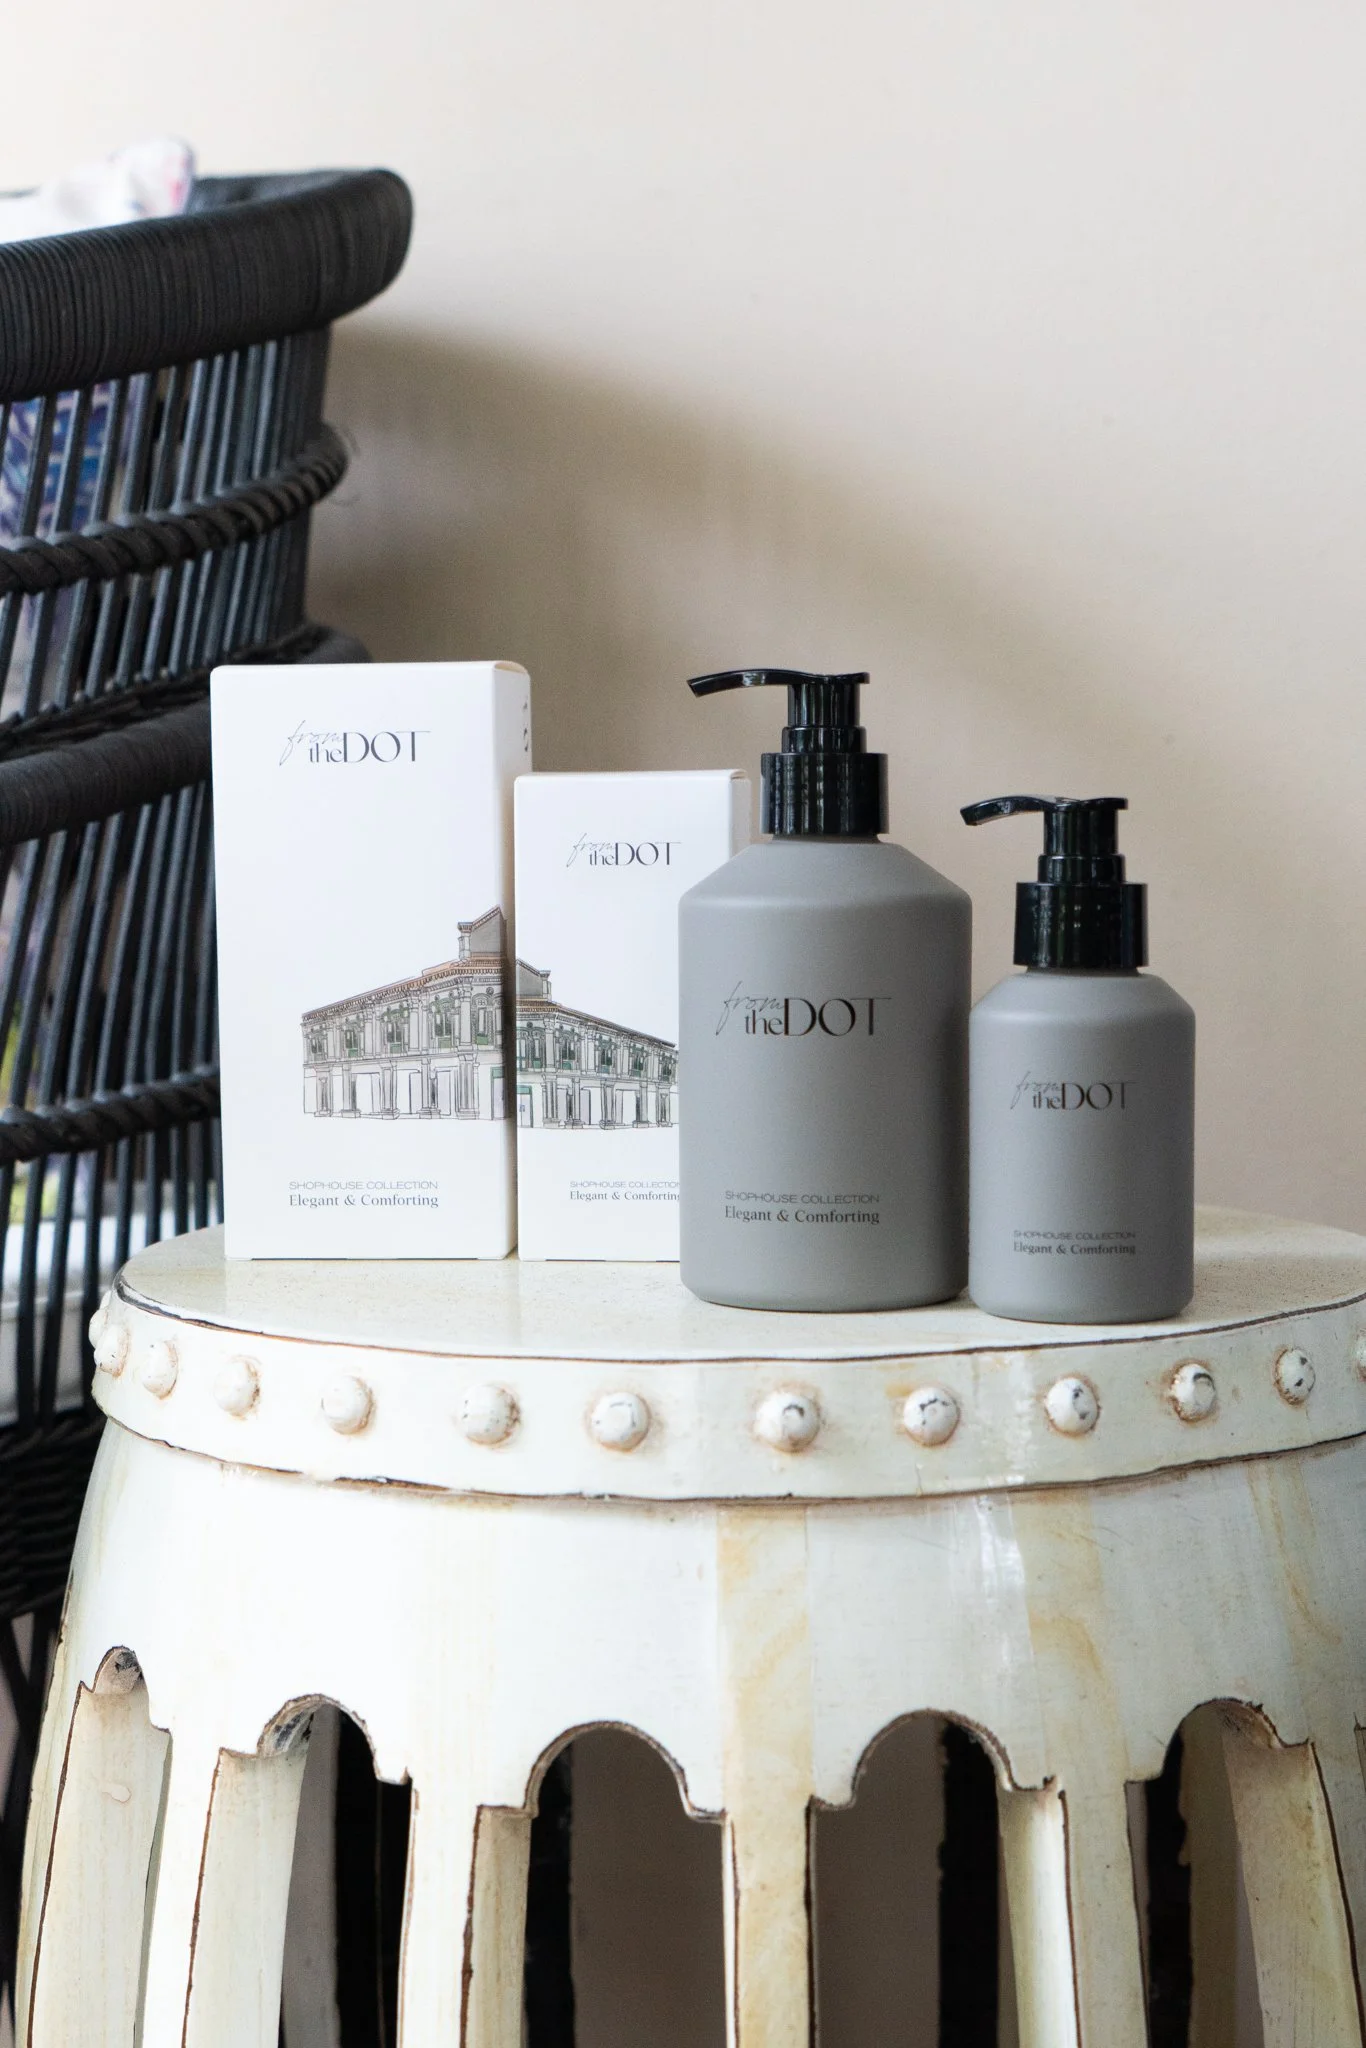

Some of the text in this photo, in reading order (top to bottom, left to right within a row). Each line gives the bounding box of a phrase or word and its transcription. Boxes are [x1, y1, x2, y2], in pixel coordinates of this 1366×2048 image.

[715, 980, 784, 1036] from
[288, 1181, 438, 1190] SHOPHOUSE COLLECTION
[569, 1181, 627, 1189] SHOPHOUSE
[289, 1194, 439, 1209] Elegant & Comforting
[569, 1191, 608, 1203] Elegant
[611, 1191, 621, 1201] &
[725, 1190, 880, 1204] SHOPHOUSE COLLECTION
[725, 1205, 880, 1224] Elegant & Comforting
[1013, 1230, 1136, 1241] SHOPHOUSE COLLECTION
[1013, 1241, 1136, 1256] Elegant & Comforting
